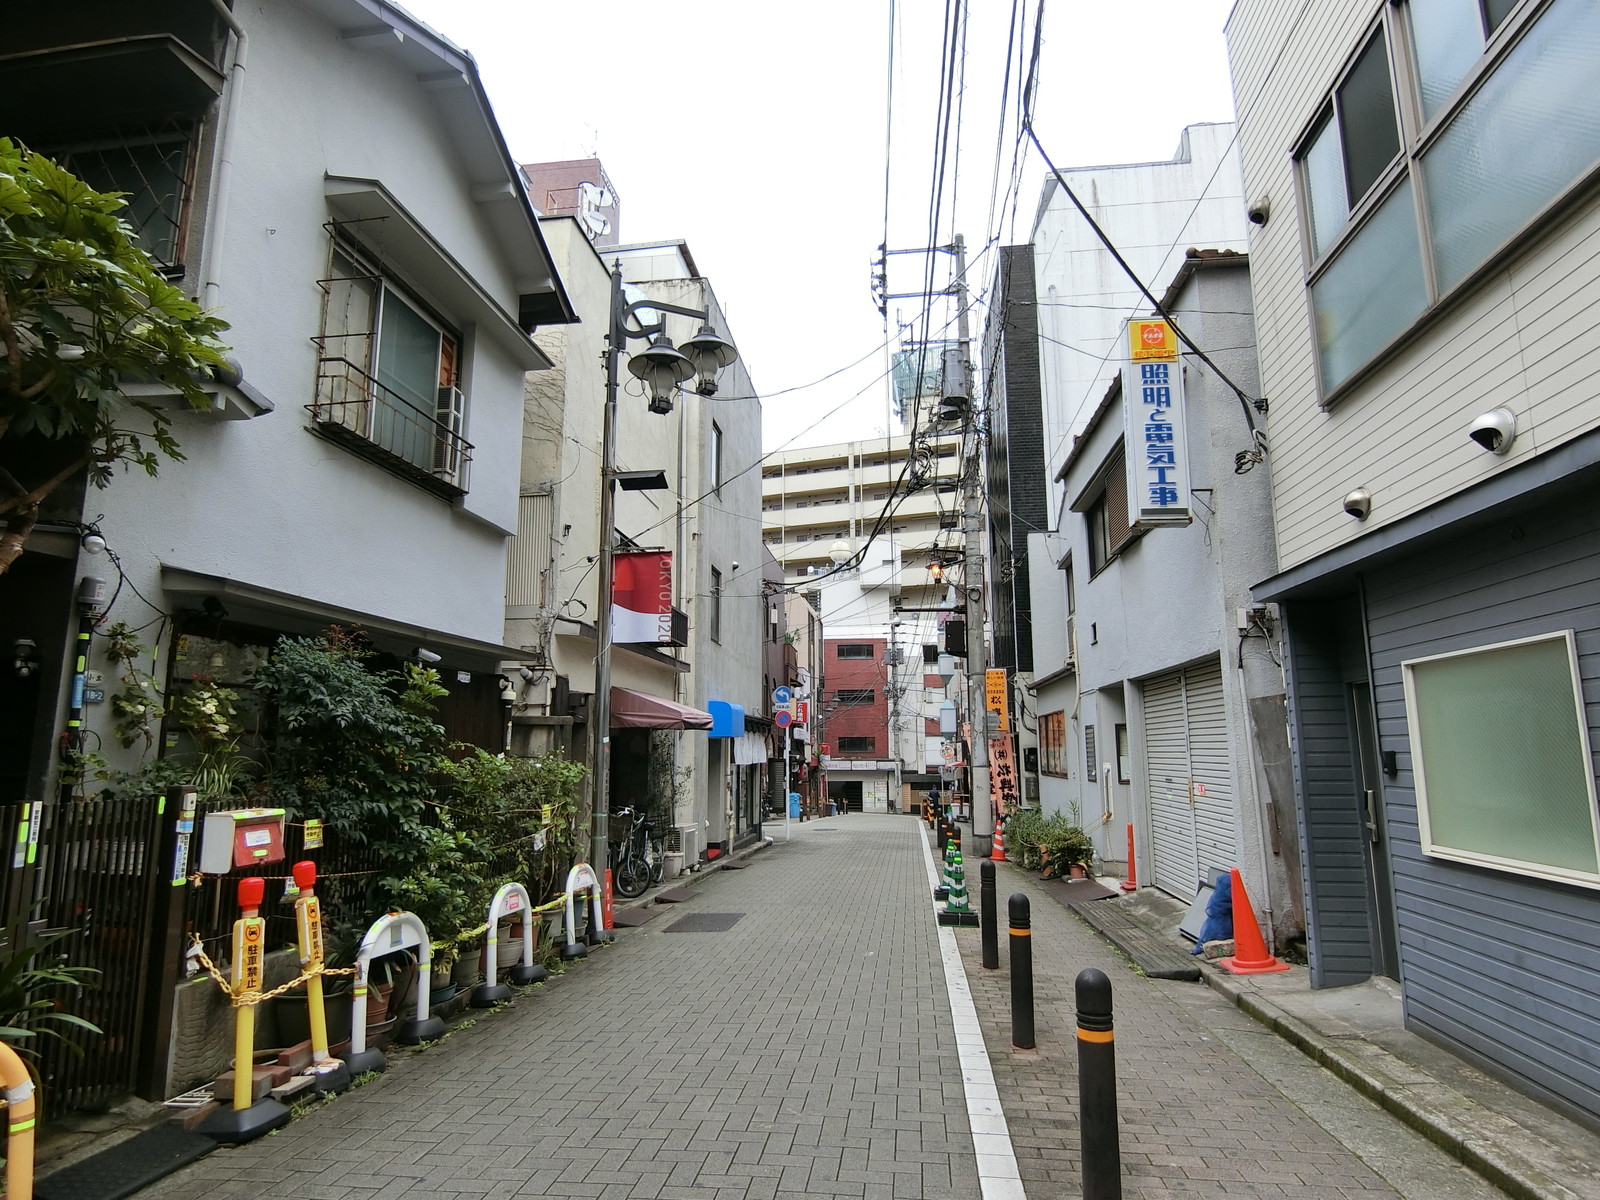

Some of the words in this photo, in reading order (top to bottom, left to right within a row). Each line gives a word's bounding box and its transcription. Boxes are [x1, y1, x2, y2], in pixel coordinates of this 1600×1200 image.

[1141, 363, 1178, 506] 照明と電気工事
[659, 554, 672, 601] OKYO
[658, 605, 672, 642] 2020
[87, 691, 103, 700] 18-2
[312, 921, 321, 960] 駐車禁止
[246, 944, 258, 989] 駐車禁止
